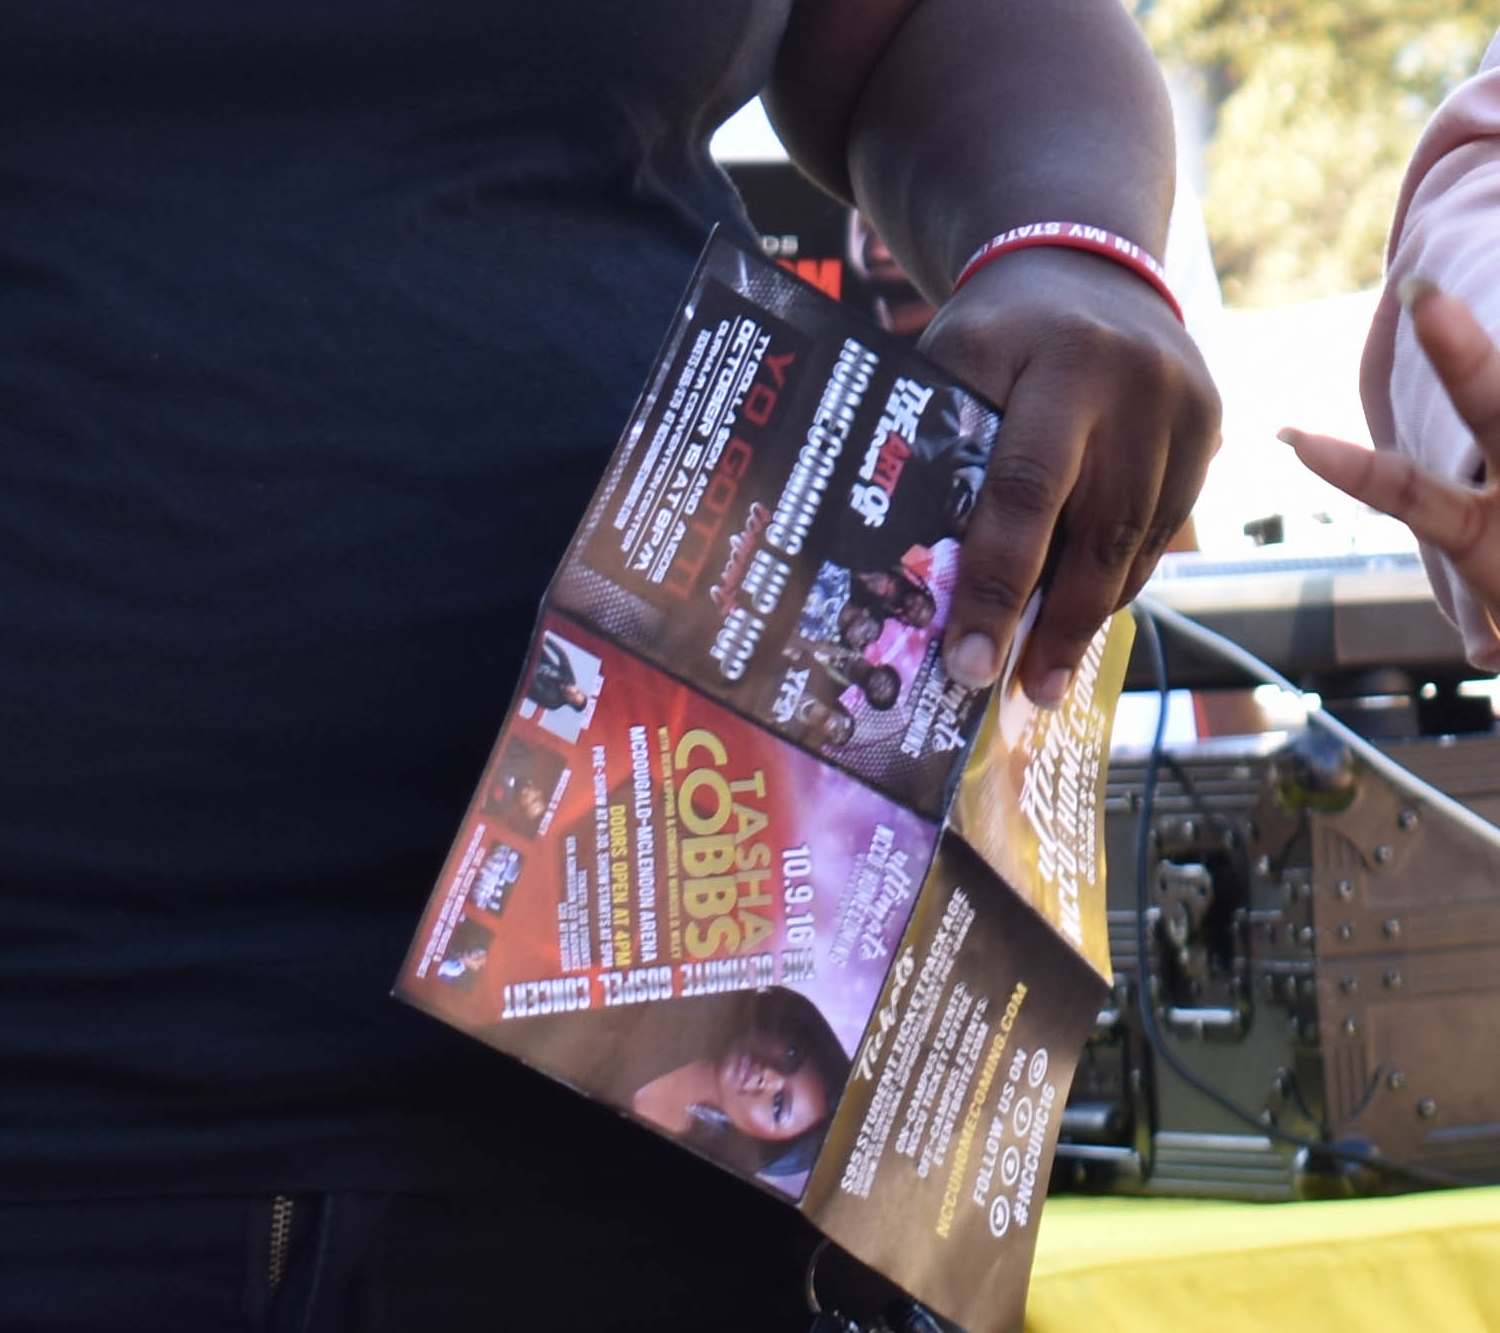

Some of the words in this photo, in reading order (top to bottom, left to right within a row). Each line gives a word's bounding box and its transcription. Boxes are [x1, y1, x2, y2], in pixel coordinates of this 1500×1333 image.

[992, 222, 1062, 247] STATE
[1067, 223, 1107, 244] MY
[693, 318, 730, 391] DURHAM
[696, 317, 756, 437] OCTOBER
[740, 343, 797, 427] YO
[647, 390, 699, 490] CONVENTION
[680, 442, 703, 469] 15
[761, 336, 882, 556] HOMECOMING
[867, 429, 914, 497] ART
[618, 488, 655, 553] CENTER
[661, 436, 755, 600] GOTTI
[663, 468, 690, 510] AT
[683, 471, 710, 516] AND
[632, 507, 673, 573] 8PM
[650, 520, 688, 585] MIGOS
[734, 548, 793, 616] HIP
[703, 605, 767, 682] HOP
[609, 804, 627, 858] DOORS
[629, 725, 653, 909] MCDOUGALD-MCLENDON
[675, 727, 739, 959] COBBS
[865, 823, 895, 868] NCCU
[611, 861, 628, 904] OPEN
[728, 769, 772, 955] TASHA
[782, 844, 814, 944] 10.9.16
[1059, 837, 1082, 945] NCCU
[597, 884, 610, 926] STARTS
[612, 907, 629, 926] AT
[639, 910, 657, 964] ARENA
[614, 930, 631, 966] 4PM
[500, 976, 591, 1018] CONCERT
[597, 966, 673, 1005] GOSPEL
[854, 1051, 901, 1151] STUDENT
[891, 979, 928, 1055] TICKET
[918, 885, 969, 983] PACKAGE
[903, 1108, 930, 1157] NCCU
[922, 1048, 951, 1108] TICKET
[935, 980, 1029, 1238] NCCUHOMECOMING.COM
[971, 1115, 1006, 1206] FOLLOW
[995, 1081, 1017, 1114] US
[1007, 1047, 1029, 1082] ON
[1011, 1080, 1057, 1229] #NCCUHC16
